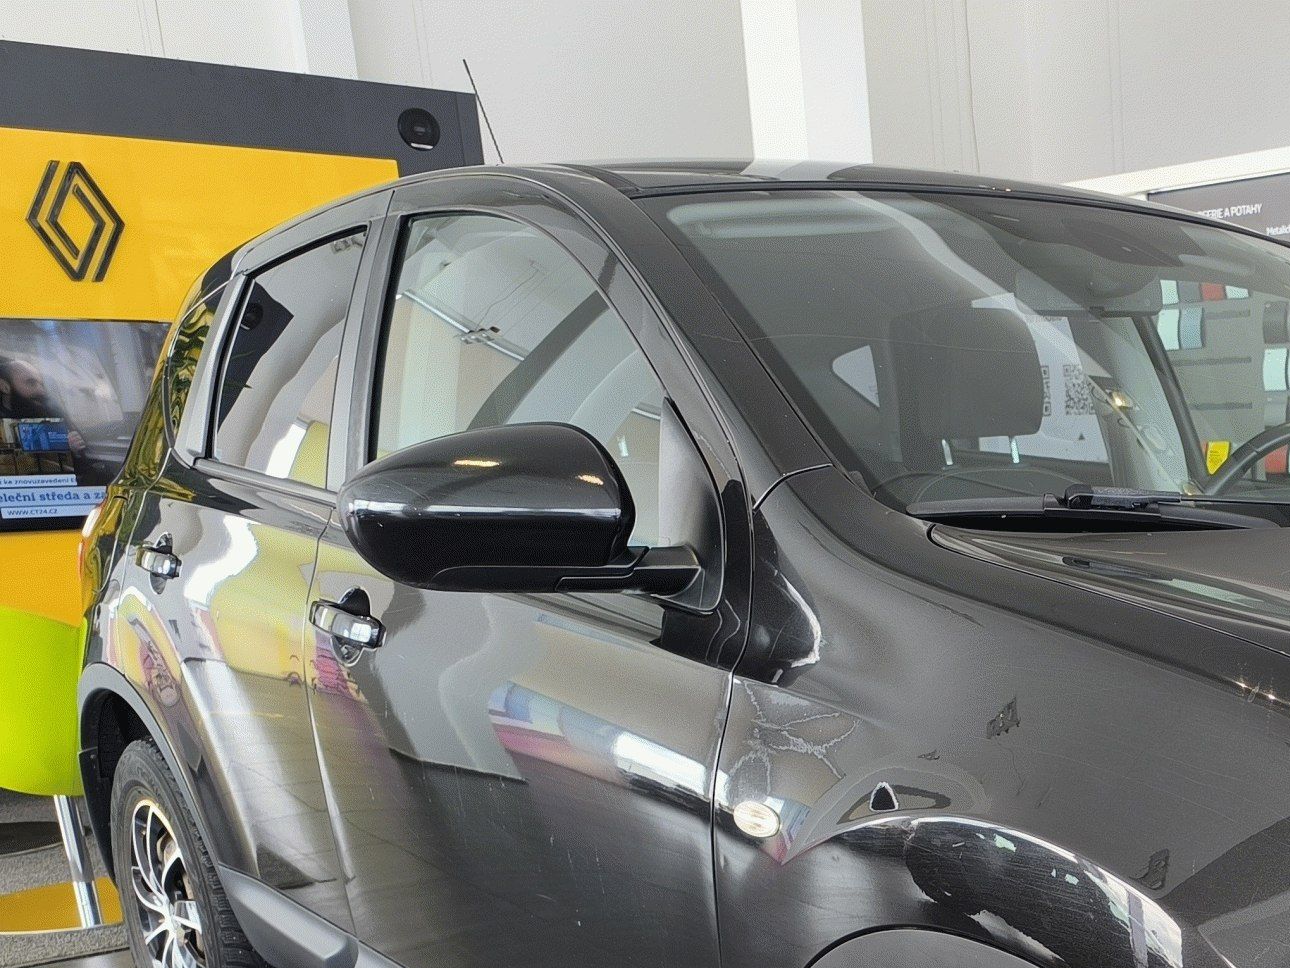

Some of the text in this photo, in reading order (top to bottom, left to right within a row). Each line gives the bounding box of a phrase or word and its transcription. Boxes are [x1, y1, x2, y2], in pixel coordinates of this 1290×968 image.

[1230, 203, 1263, 217] POTAHY
[40, 491, 79, 501] středa
[83, 492, 91, 500] a
